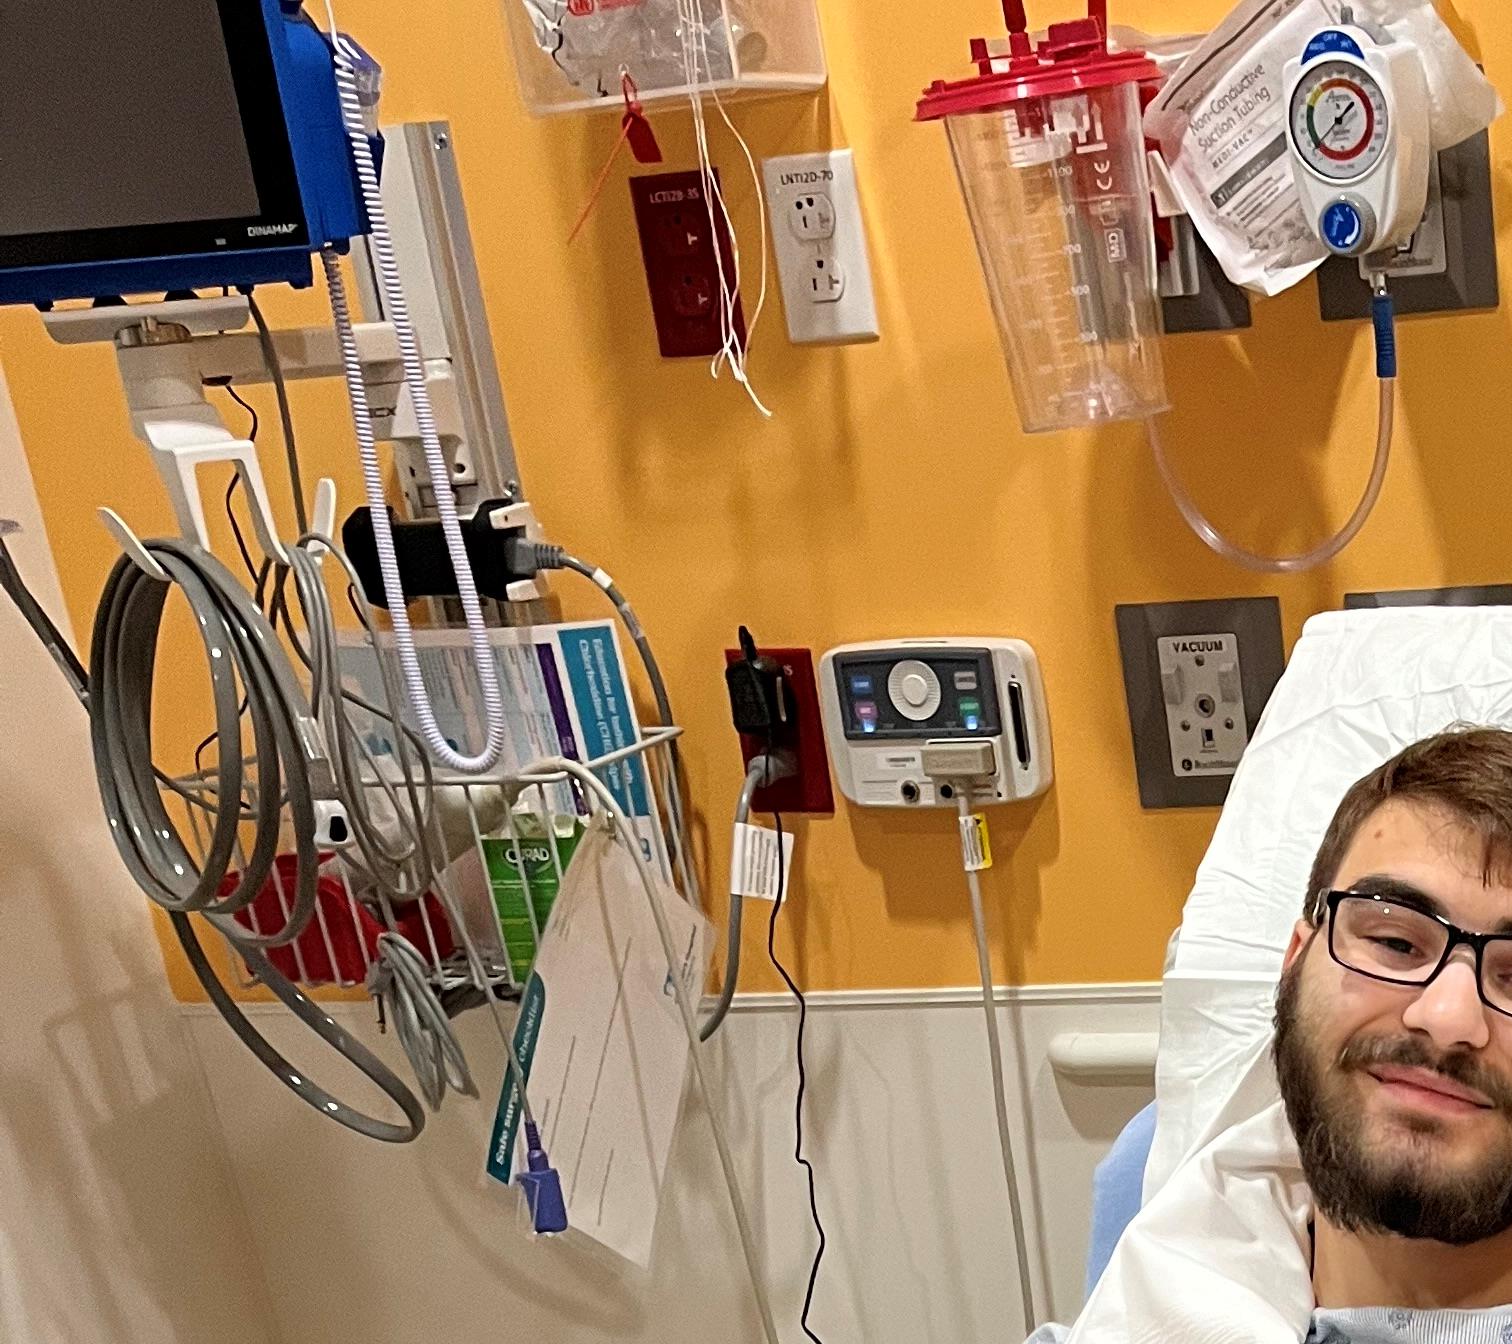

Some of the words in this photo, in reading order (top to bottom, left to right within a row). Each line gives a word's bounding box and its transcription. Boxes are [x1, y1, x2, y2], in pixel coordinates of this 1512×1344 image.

[1189, 63, 1267, 137] Non-Conductive
[1198, 115, 1237, 152] Suction
[1233, 86, 1272, 120] Tubing
[247, 223, 299, 237] DINAMAP
[1172, 640, 1224, 653] VACUUM
